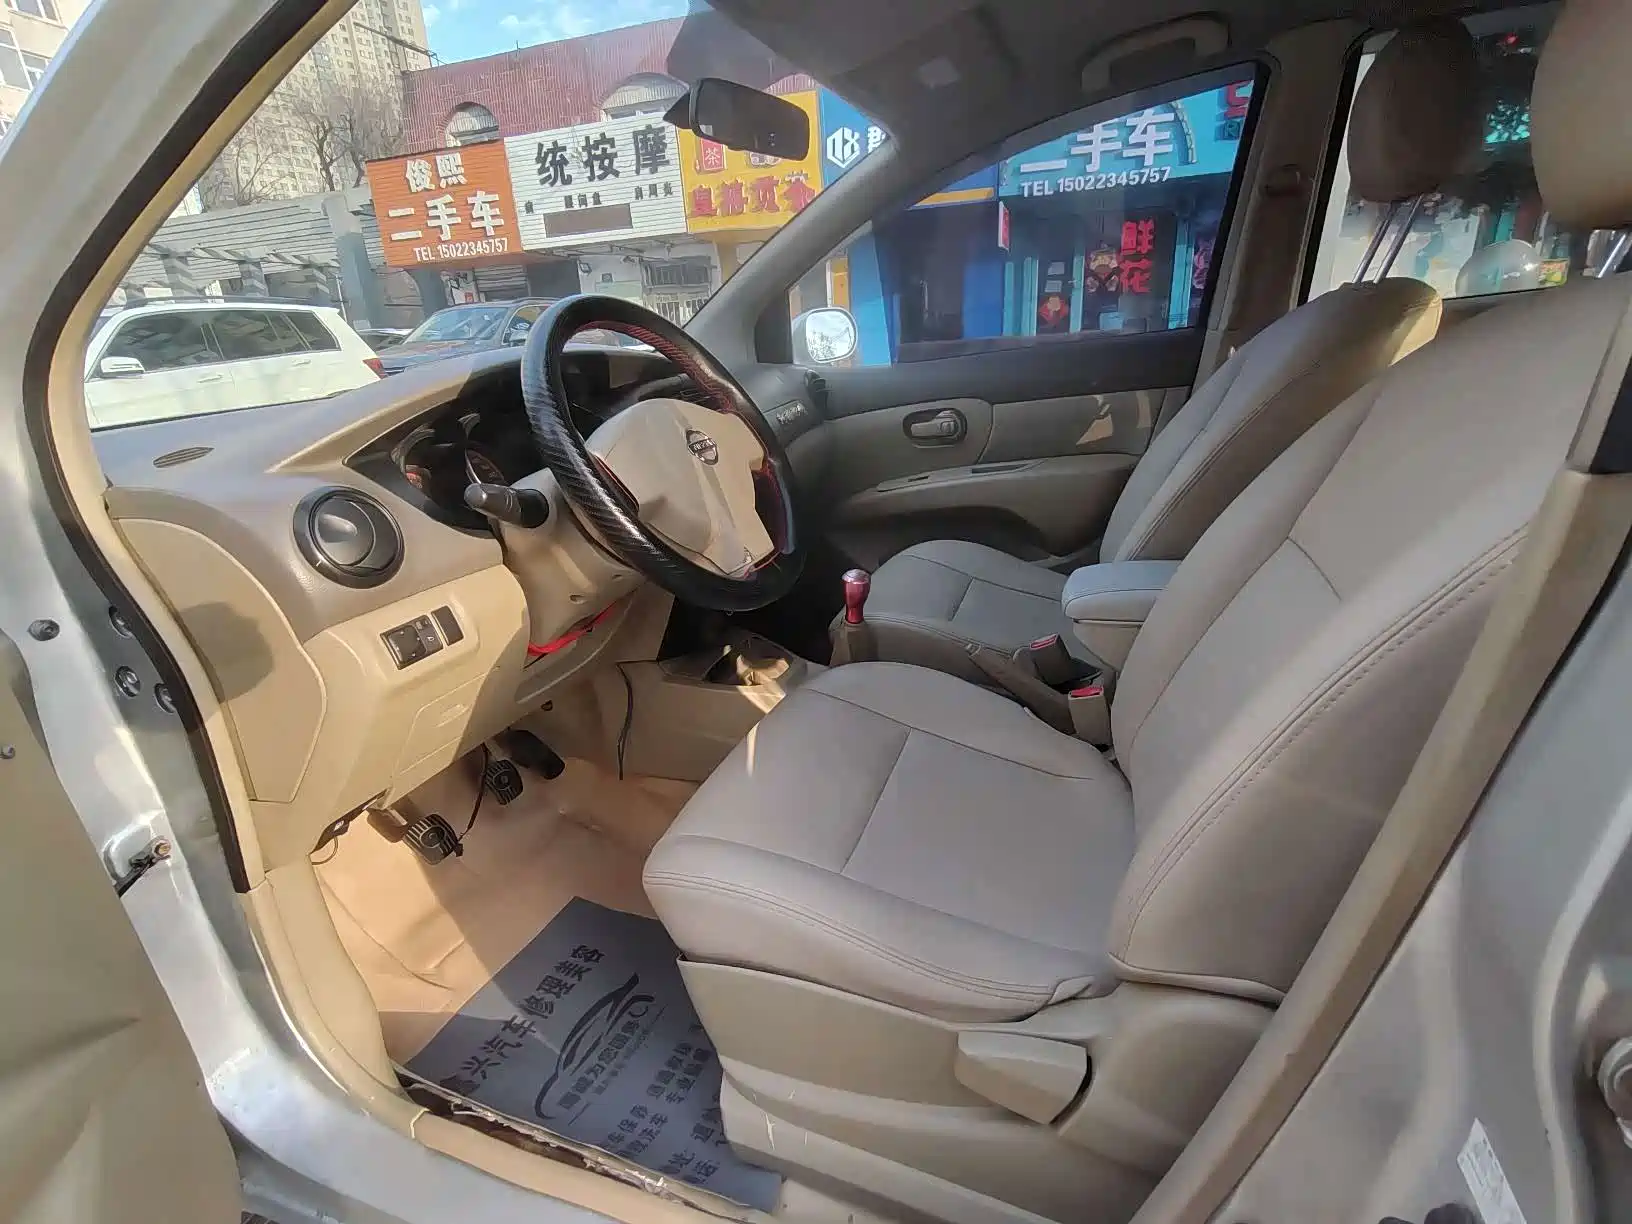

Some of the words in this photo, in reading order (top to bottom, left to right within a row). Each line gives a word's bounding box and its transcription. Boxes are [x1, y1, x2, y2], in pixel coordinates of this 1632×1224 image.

[405, 152, 468, 193] 俊熙
[535, 124, 670, 187] 统按摩
[704, 147, 721, 166] 茶
[1020, 180, 1054, 198] TEL
[1057, 166, 1172, 193] 15022345757
[388, 190, 505, 241] 二手车
[413, 246, 436, 262] TEL
[437, 237, 508, 259] 15022345757
